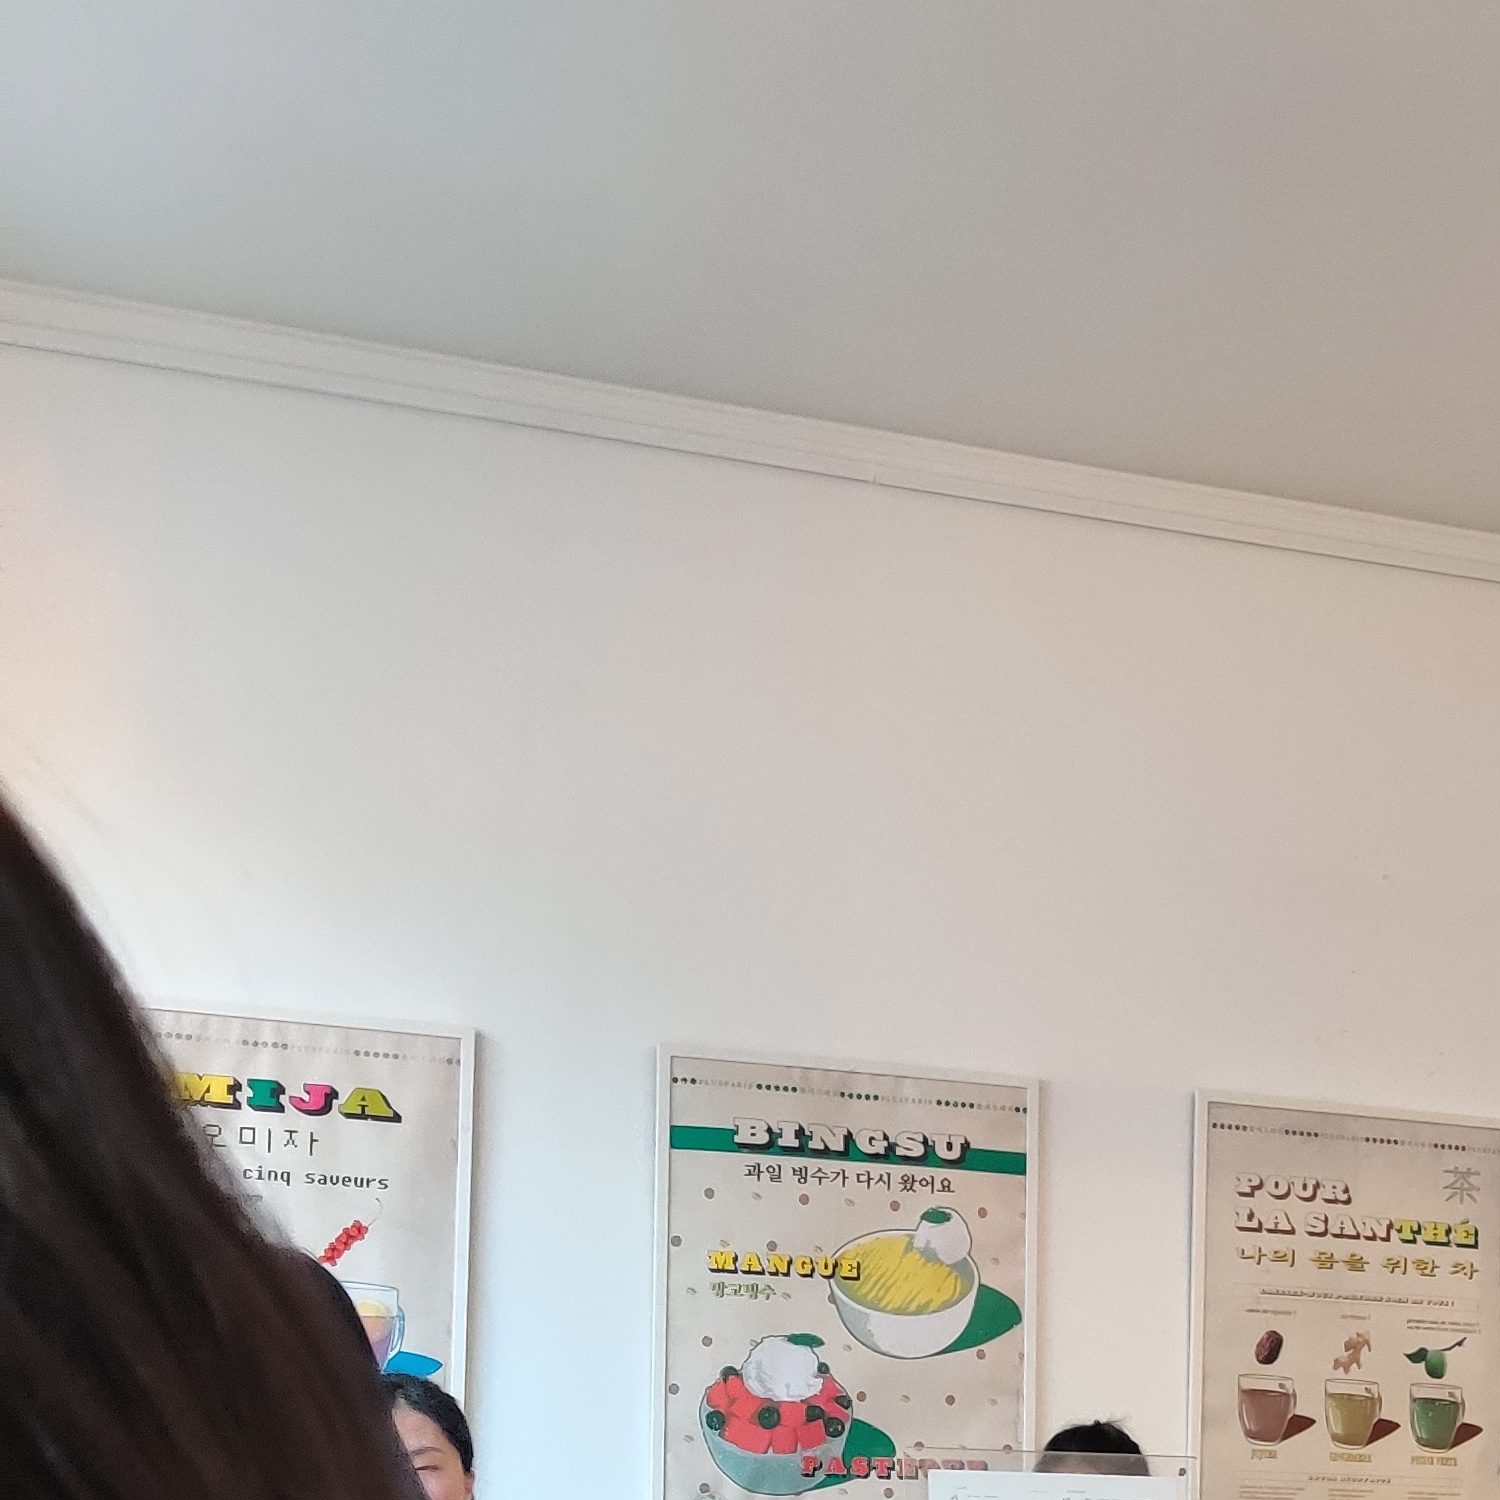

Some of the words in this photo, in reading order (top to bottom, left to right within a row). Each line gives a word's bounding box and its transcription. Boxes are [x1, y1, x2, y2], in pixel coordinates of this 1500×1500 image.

[733, 1117, 970, 1164] BINGSU
[242, 1166, 291, 1187] cinq
[304, 1171, 389, 1190] saveurs
[744, 1162, 783, 1183] 과일
[791, 1165, 849, 1188] 빙수가
[855, 1171, 892, 1193] 다시
[898, 1174, 955, 1195] 왔어요
[1235, 1172, 1352, 1204] POUR
[1442, 1166, 1481, 1205] 茶
[1235, 1206, 1296, 1235] LA
[1304, 1212, 1479, 1250] SANTHÉ
[706, 1250, 862, 1281] MANGUE
[1236, 1246, 1296, 1267] 나의
[1380, 1255, 1440, 1277] 위한
